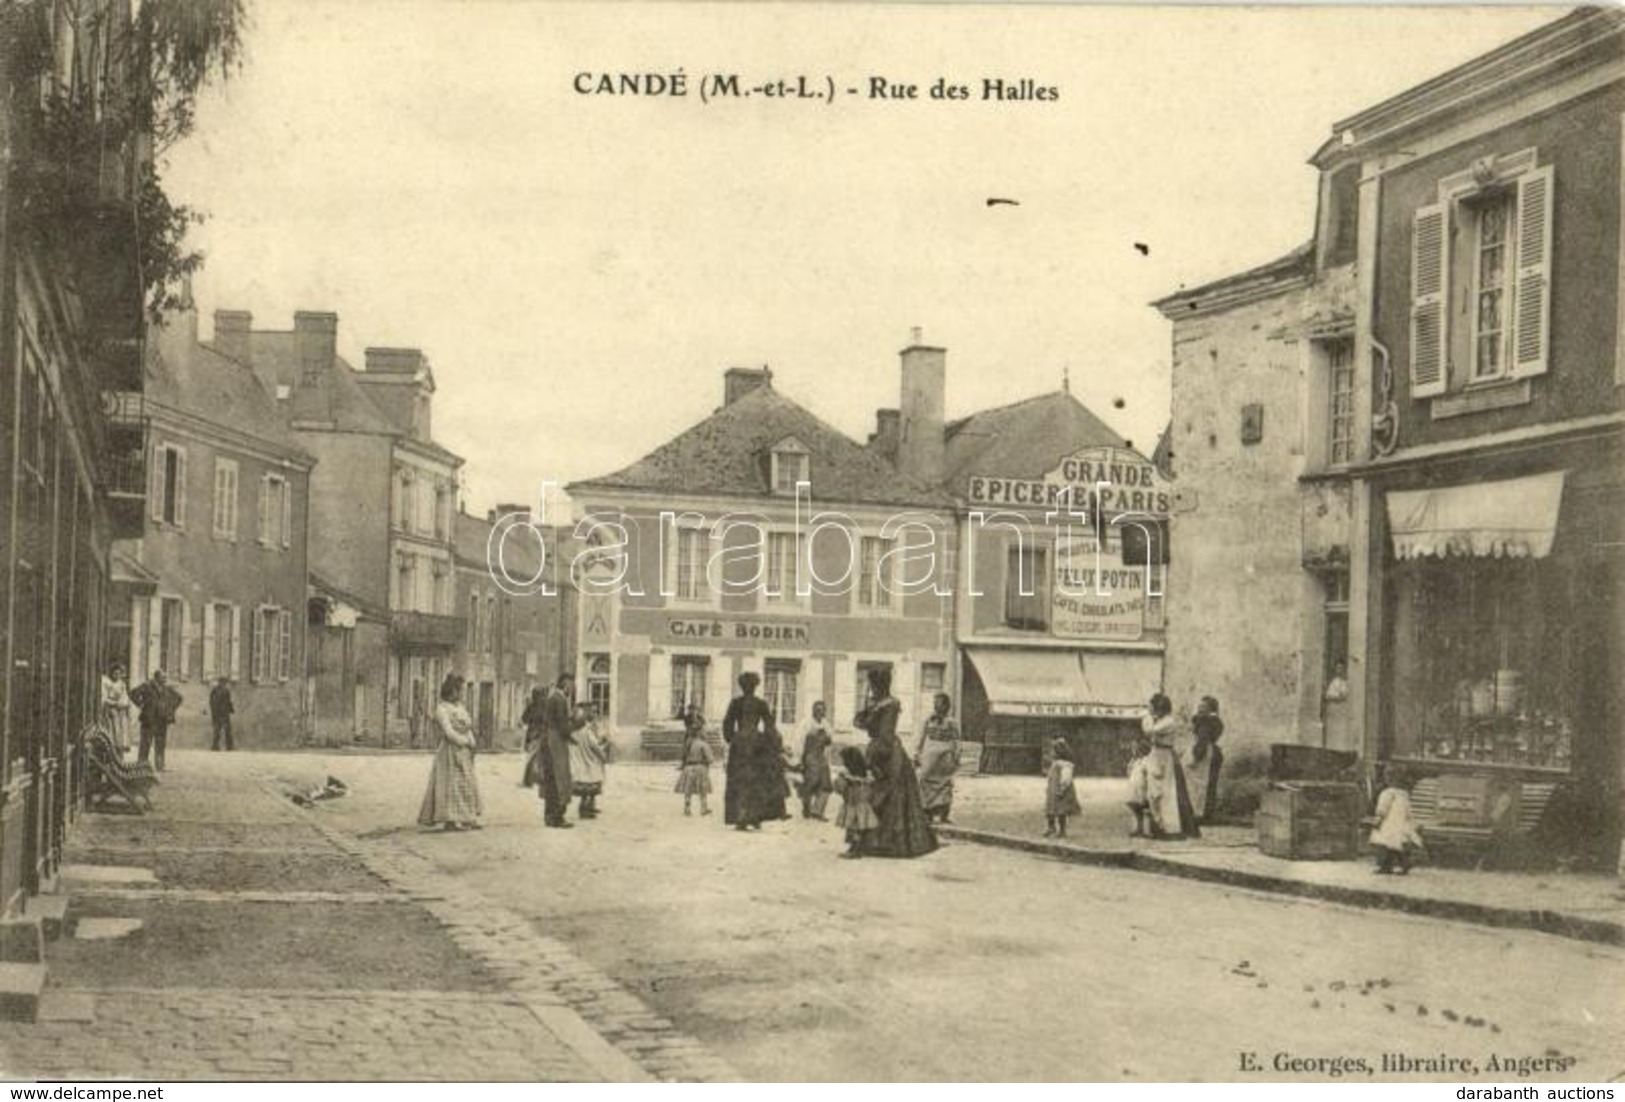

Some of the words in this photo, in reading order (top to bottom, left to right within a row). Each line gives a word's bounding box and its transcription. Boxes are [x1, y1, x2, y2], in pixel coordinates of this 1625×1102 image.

[1062, 459, 1154, 488] GRANDE
[1100, 488, 1170, 513] PARIS
[1101, 569, 1141, 590] POTIN
[669, 618, 723, 637] CAFÉ
[734, 622, 806, 640] BODIER
